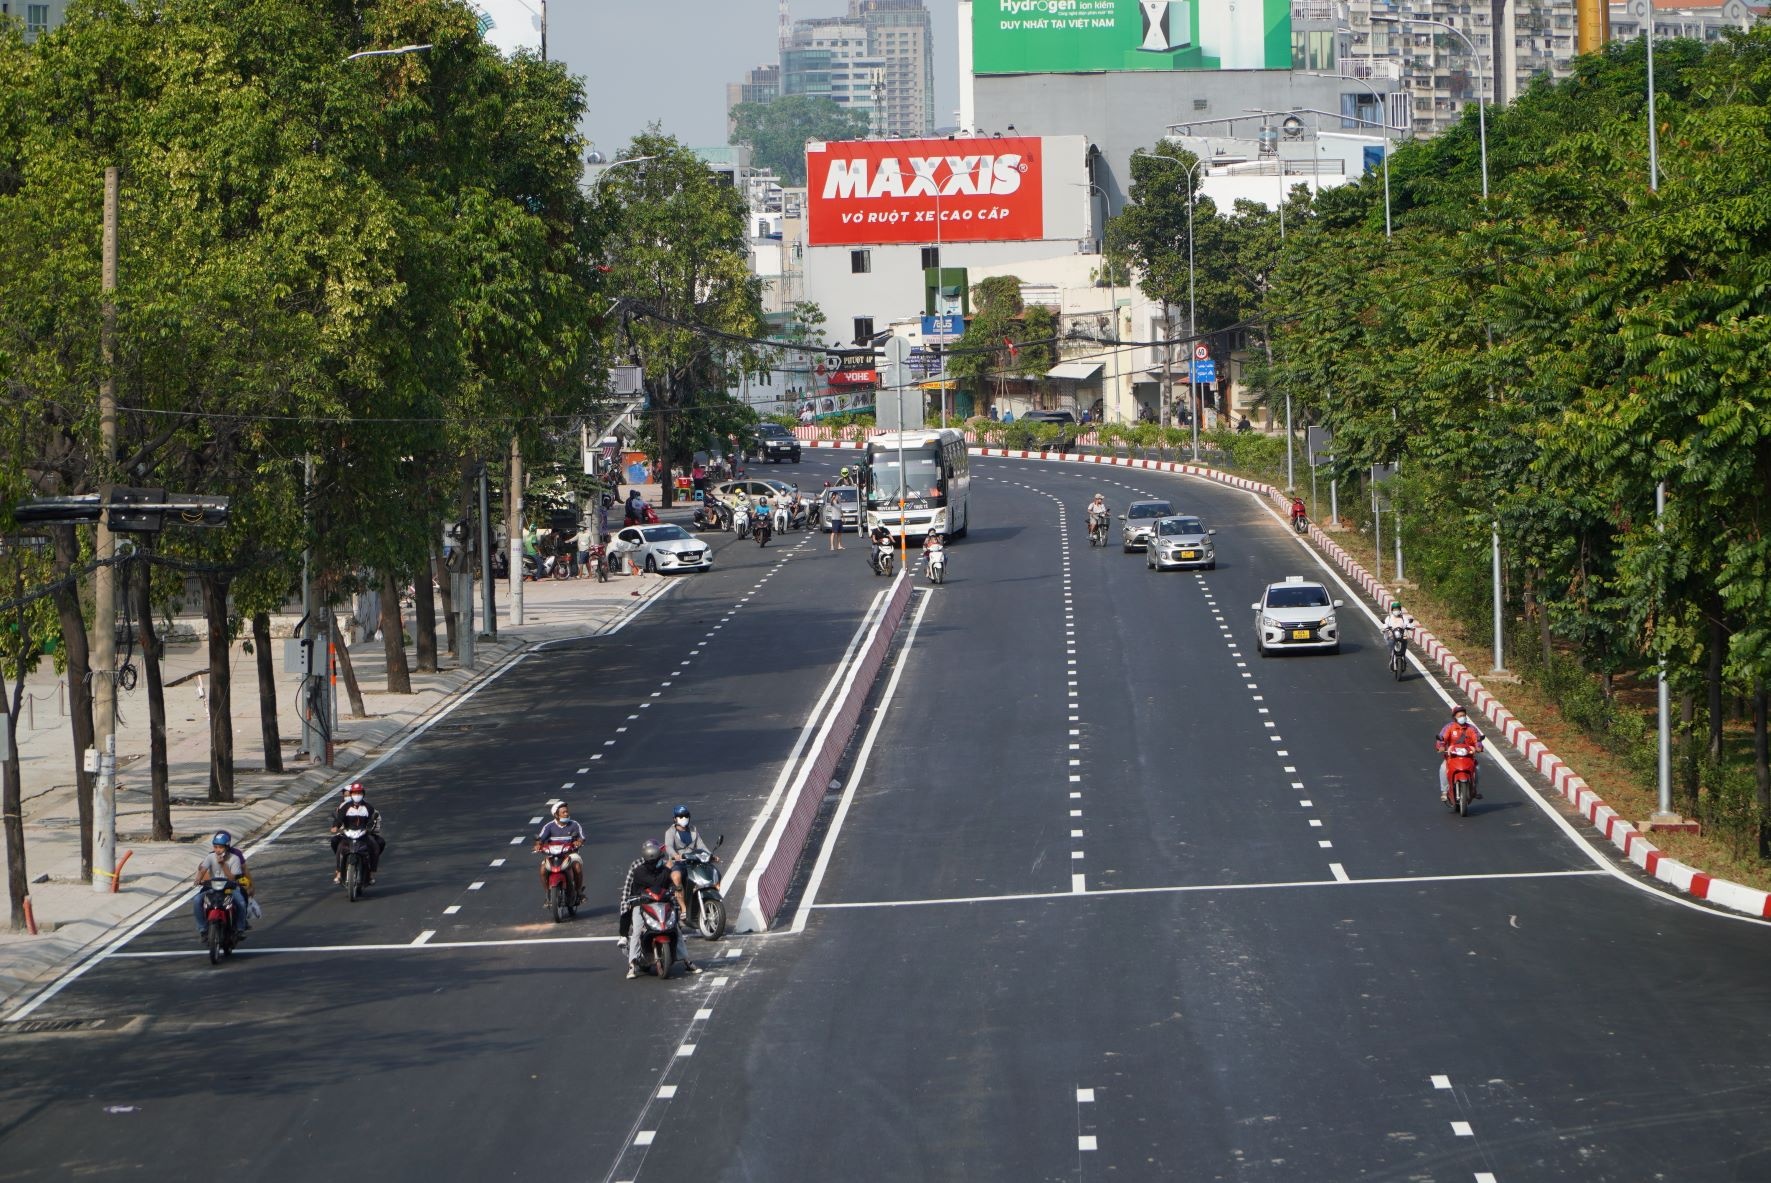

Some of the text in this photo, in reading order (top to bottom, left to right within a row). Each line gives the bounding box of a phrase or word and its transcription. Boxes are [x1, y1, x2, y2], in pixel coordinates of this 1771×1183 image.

[1000, 18, 1115, 30] DUY NHẤT TẠI VIỆT NAM
[821, 153, 1022, 199] MAXXIS
[841, 207, 1010, 225] VỎ RUỘT XE CAO CẤP
[844, 372, 869, 381] YOHE
